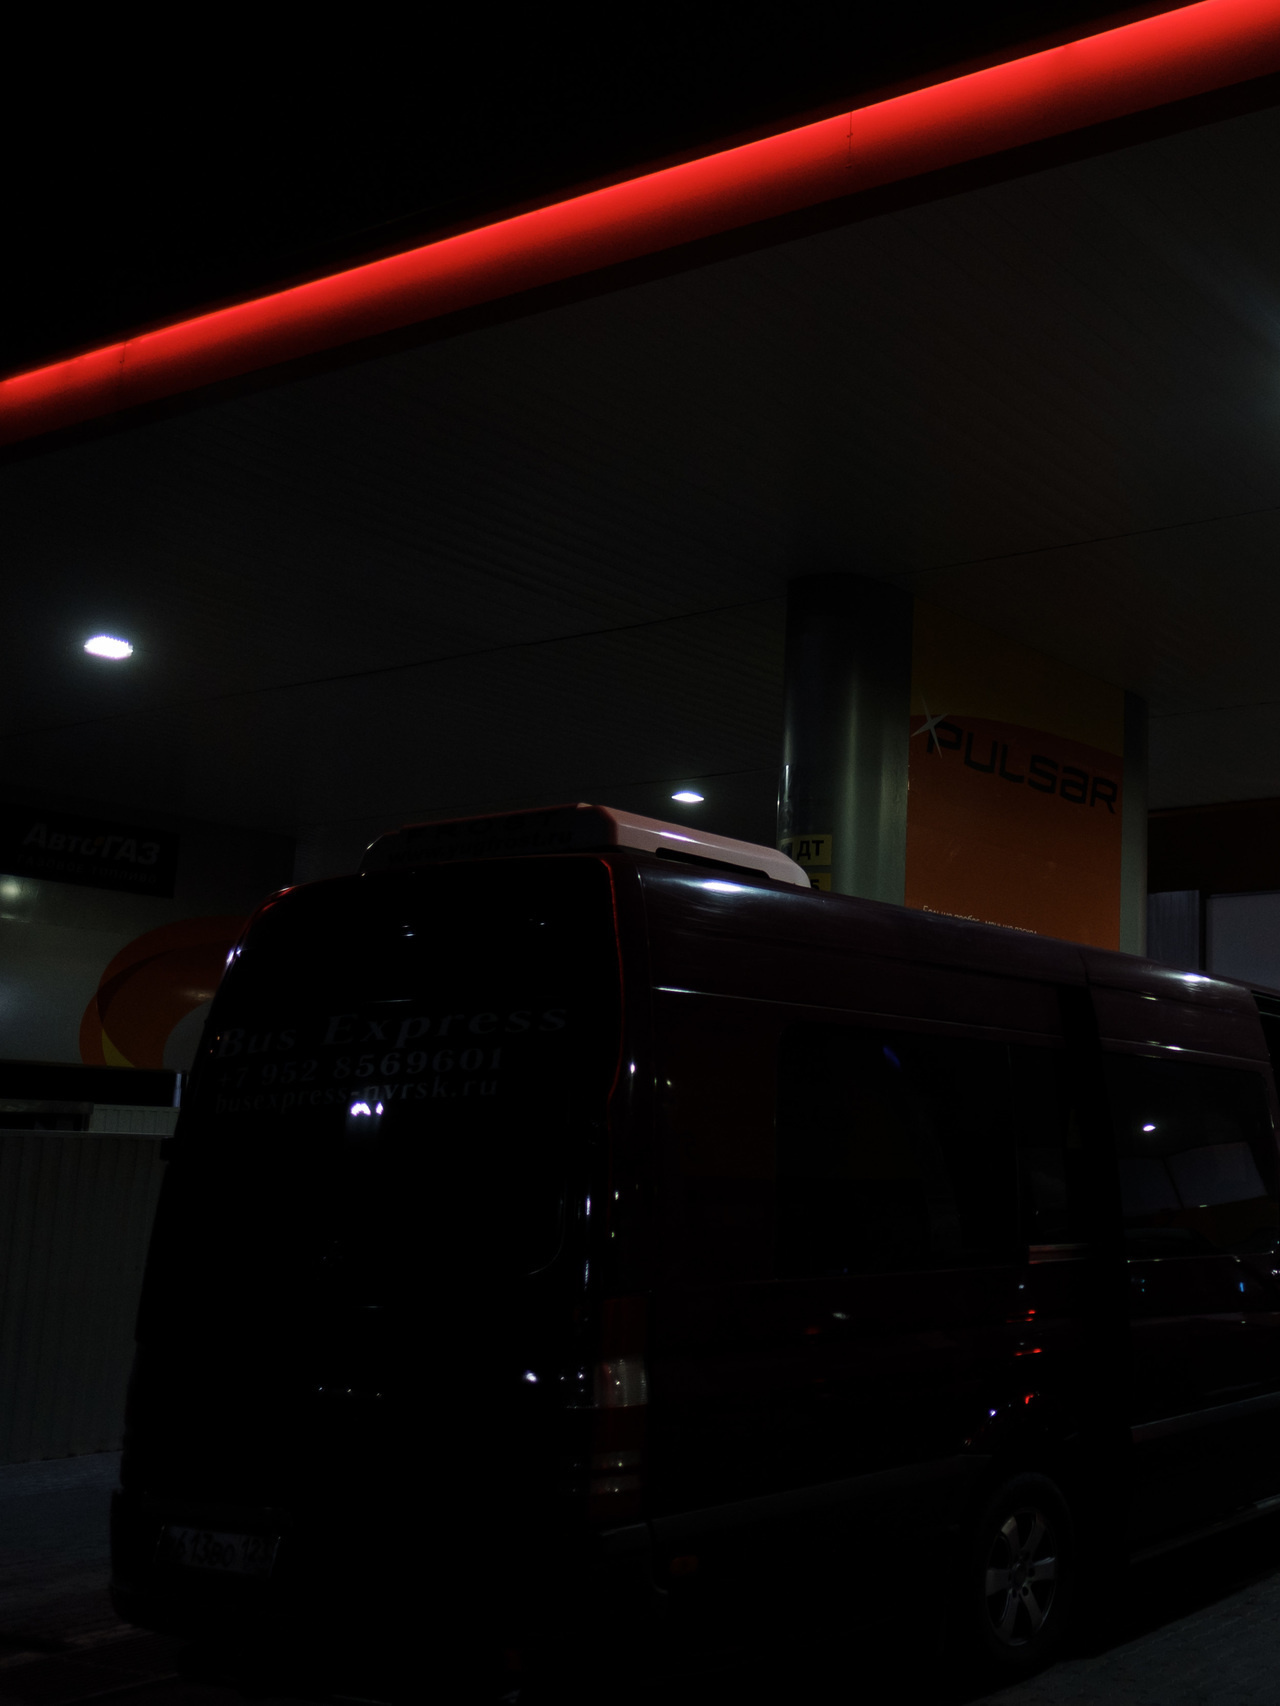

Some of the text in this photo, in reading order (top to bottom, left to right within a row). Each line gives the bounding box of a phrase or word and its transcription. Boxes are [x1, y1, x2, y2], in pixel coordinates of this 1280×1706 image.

[407, 811, 560, 843] FROST
[389, 831, 572, 864] www.yugfrost.ru
[796, 840, 824, 860] ДТ
[16, 853, 157, 885] ГАЗОВОЕ ТОПЛИВО
[214, 1007, 569, 1060] Bus Express
[217, 1046, 505, 1089] +7 952 8569601
[214, 1076, 499, 1115] busexpress-nvrsk.ru
